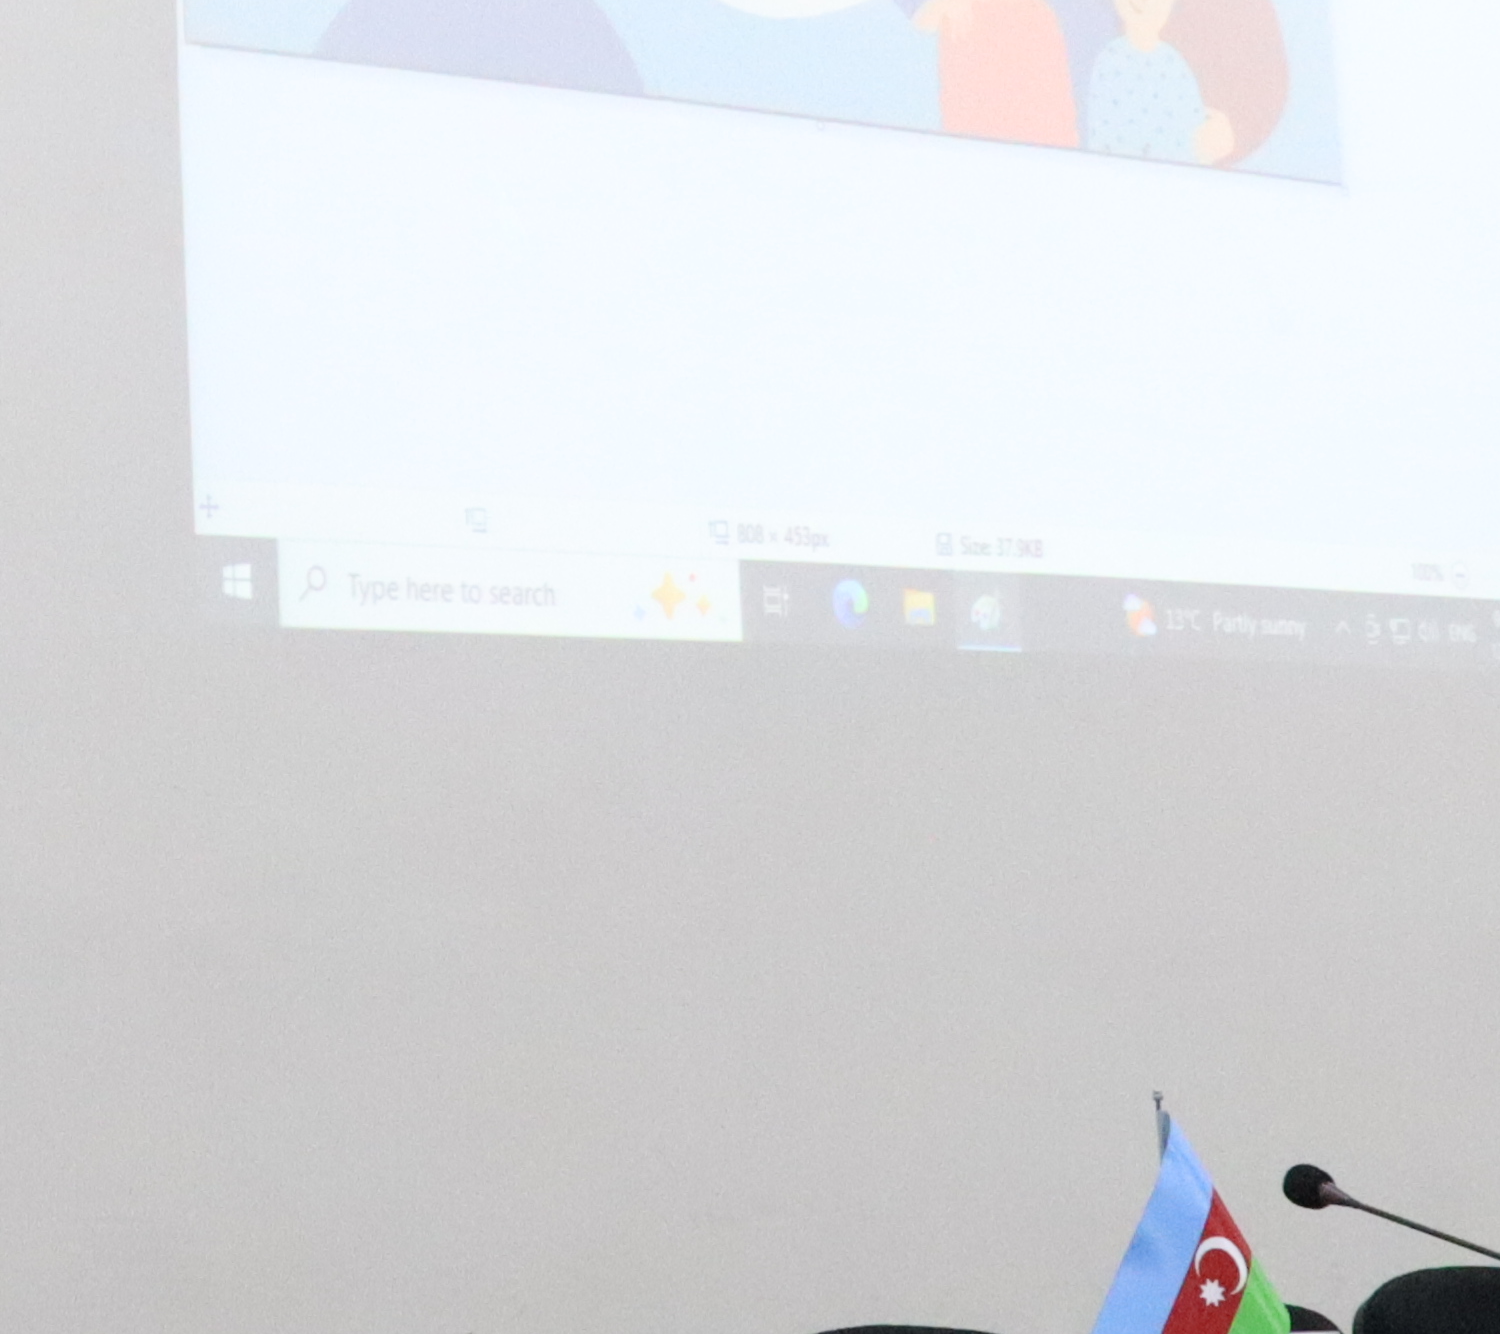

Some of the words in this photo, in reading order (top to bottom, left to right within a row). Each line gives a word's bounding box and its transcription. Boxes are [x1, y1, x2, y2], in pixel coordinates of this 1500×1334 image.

[348, 572, 398, 606] Type
[406, 575, 454, 603] here
[460, 580, 482, 605] to
[488, 582, 557, 607] search
[1212, 609, 1257, 640] Partly
[1260, 619, 1307, 642] sunny
